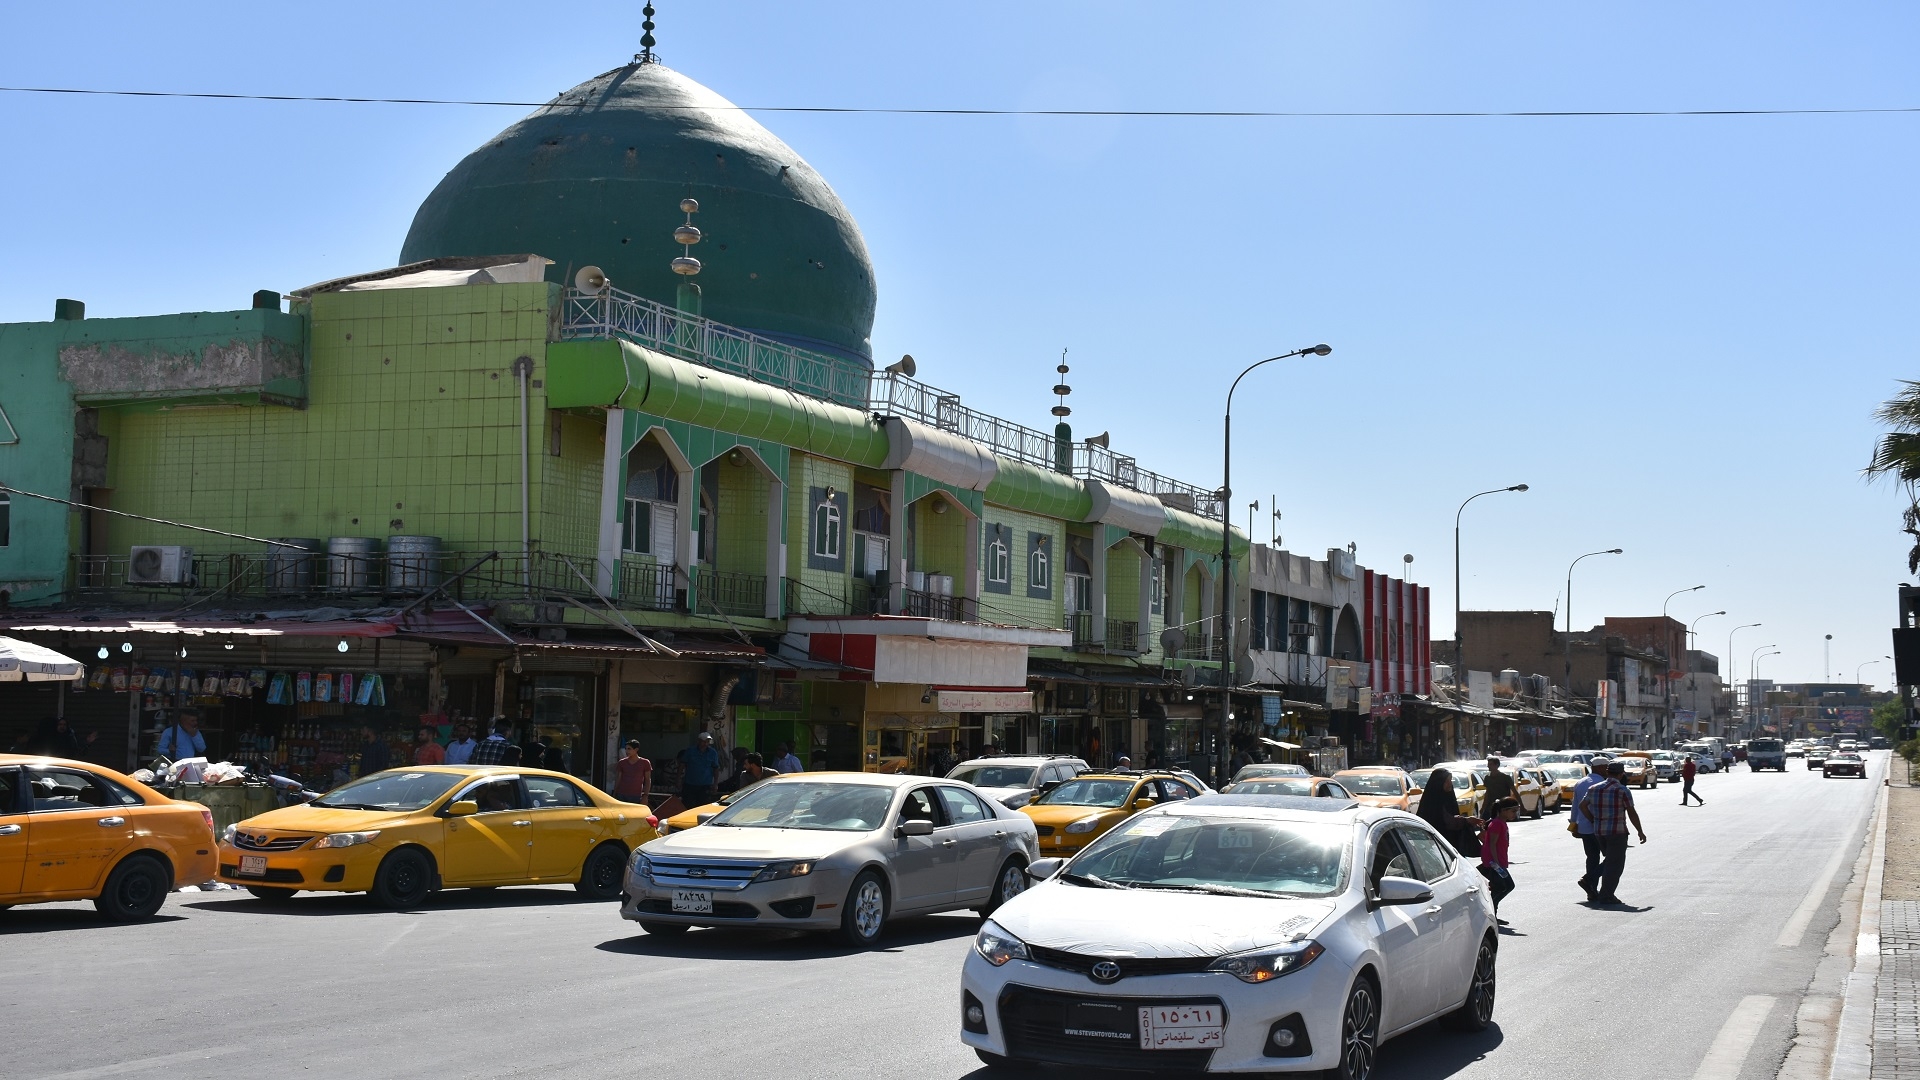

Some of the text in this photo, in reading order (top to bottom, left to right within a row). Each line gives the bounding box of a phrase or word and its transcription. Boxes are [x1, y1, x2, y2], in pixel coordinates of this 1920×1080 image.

[1221, 835, 1249, 848] 870
[1160, 1009, 1212, 1024] ١٥٠٦١
[1065, 1029, 1132, 1039] WWW.STEVENTOYOTA.COM
